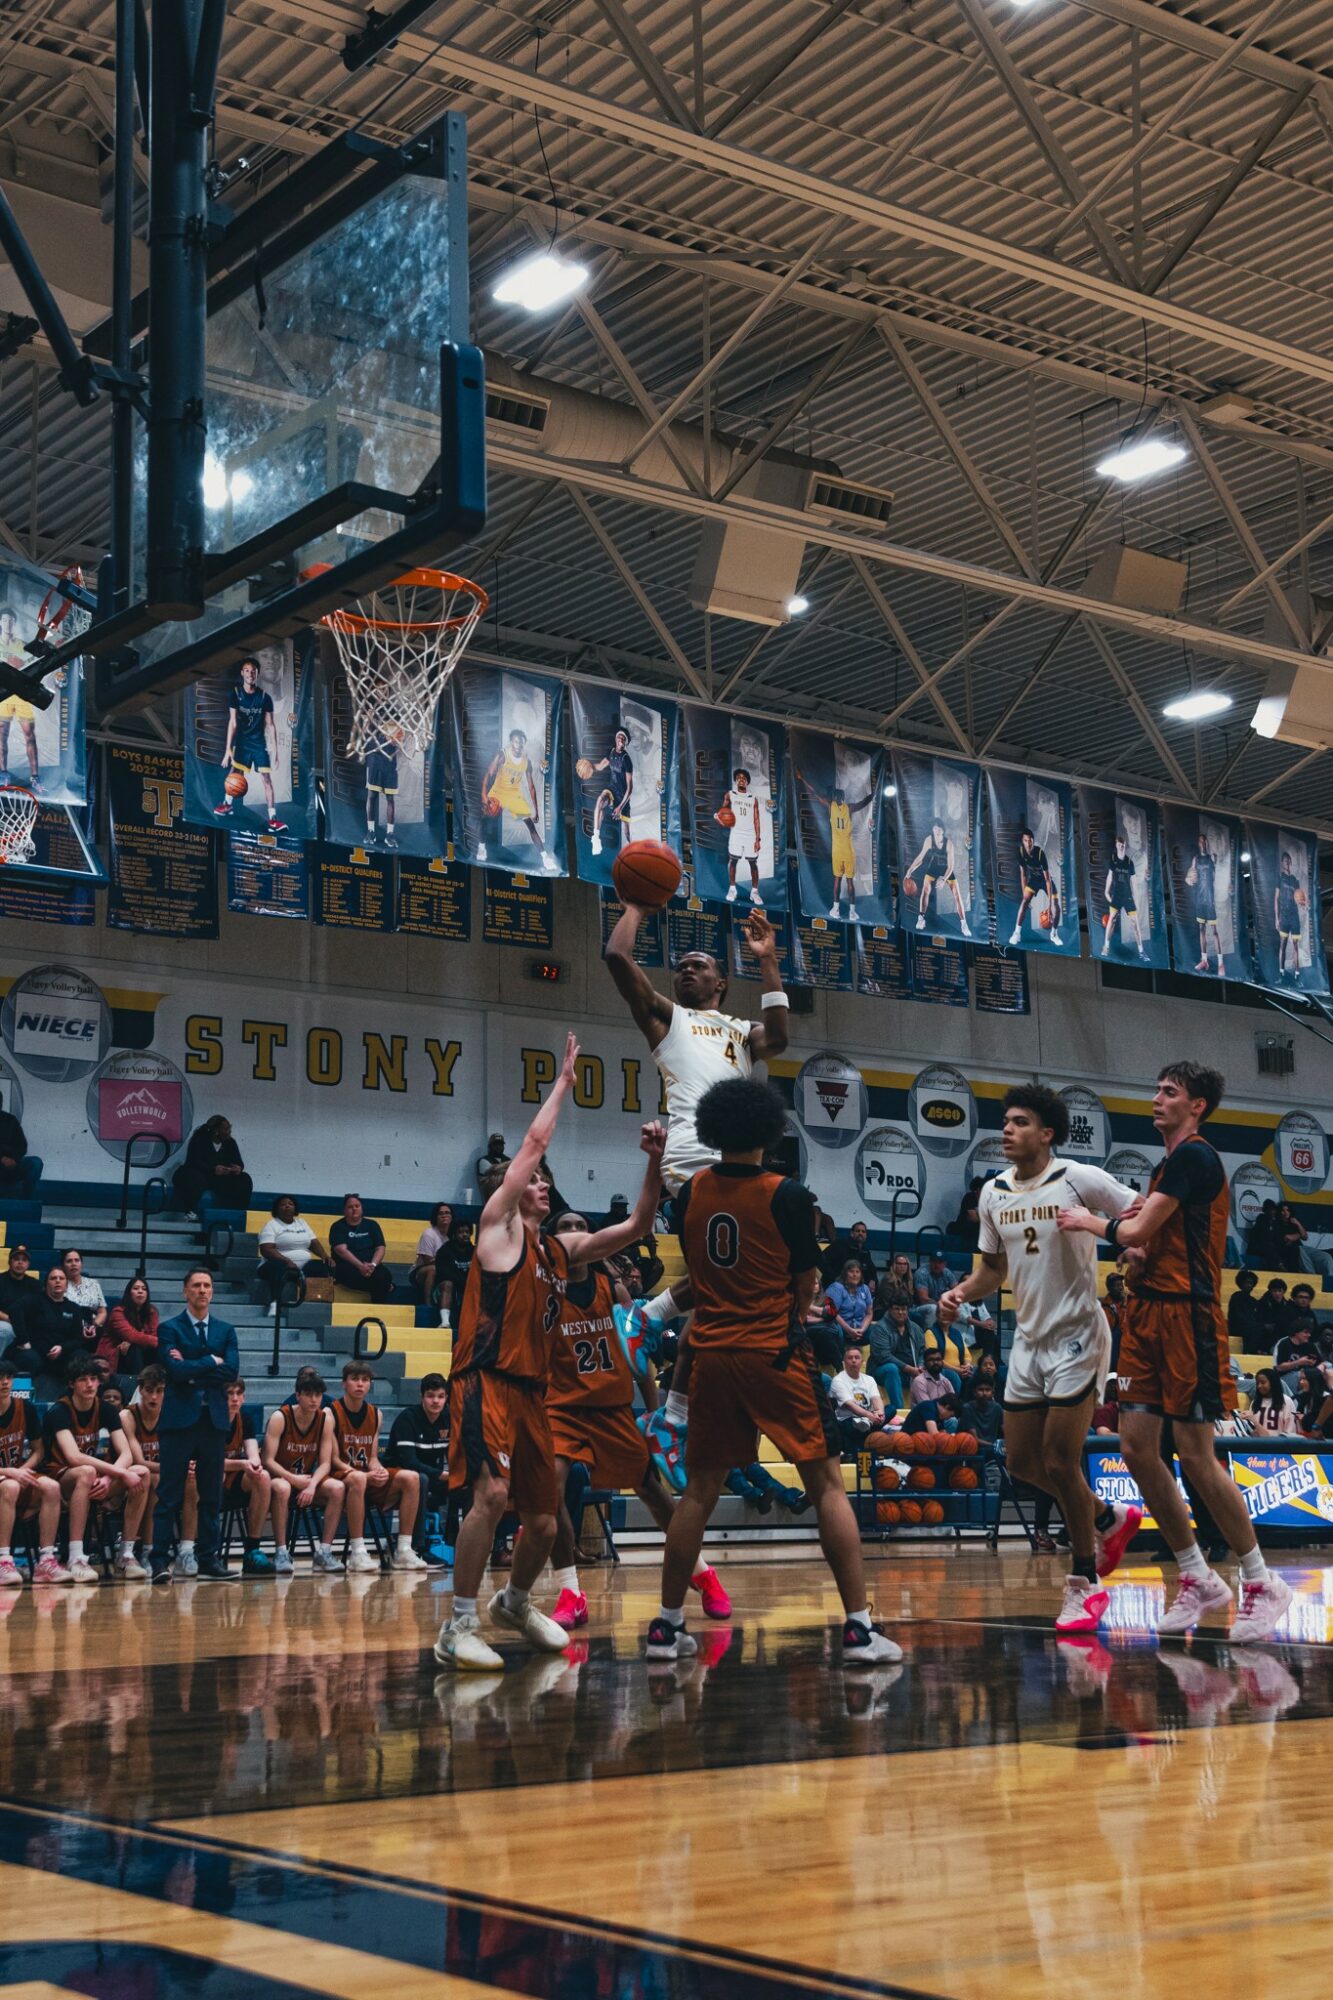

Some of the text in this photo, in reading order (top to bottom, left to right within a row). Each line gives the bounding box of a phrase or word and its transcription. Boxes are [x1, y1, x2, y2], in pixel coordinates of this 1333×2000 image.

[112, 748, 142, 762] BOYS
[129, 762, 157, 777] 2022
[837, 816, 845, 829] 11
[114, 823, 145, 834] OVERALL
[146, 828, 174, 839] RECORD
[320, 863, 384, 879] BI-DISTRICT QUALIFIERS
[50, 981, 94, 994] Volleyball
[16, 1012, 99, 1039] NIECE
[691, 1024, 723, 1037] STONY
[724, 1041, 738, 1066] 4
[109, 1064, 174, 1077] Tiger Volleyball
[185, 1014, 668, 1115] STONY POI
[116, 1105, 168, 1121] VOLLEYWORLD
[926, 1105, 961, 1121] ASCO
[1295, 1151, 1310, 1166] 66
[999, 1205, 1060, 1226] STONY POINT
[705, 1211, 741, 1270] 0
[1023, 1226, 1040, 1255] 2
[573, 1335, 615, 1374] 21
[1116, 1376, 1132, 1392] W
[286, 1441, 318, 1453] WESTWOOD
[344, 1433, 373, 1446] WESTWOOD
[346, 1446, 369, 1468] 14
[1247, 1456, 1291, 1473] Home of the
[291, 1456, 305, 1475] 4
[1242, 1457, 1318, 1521] TIGERS
